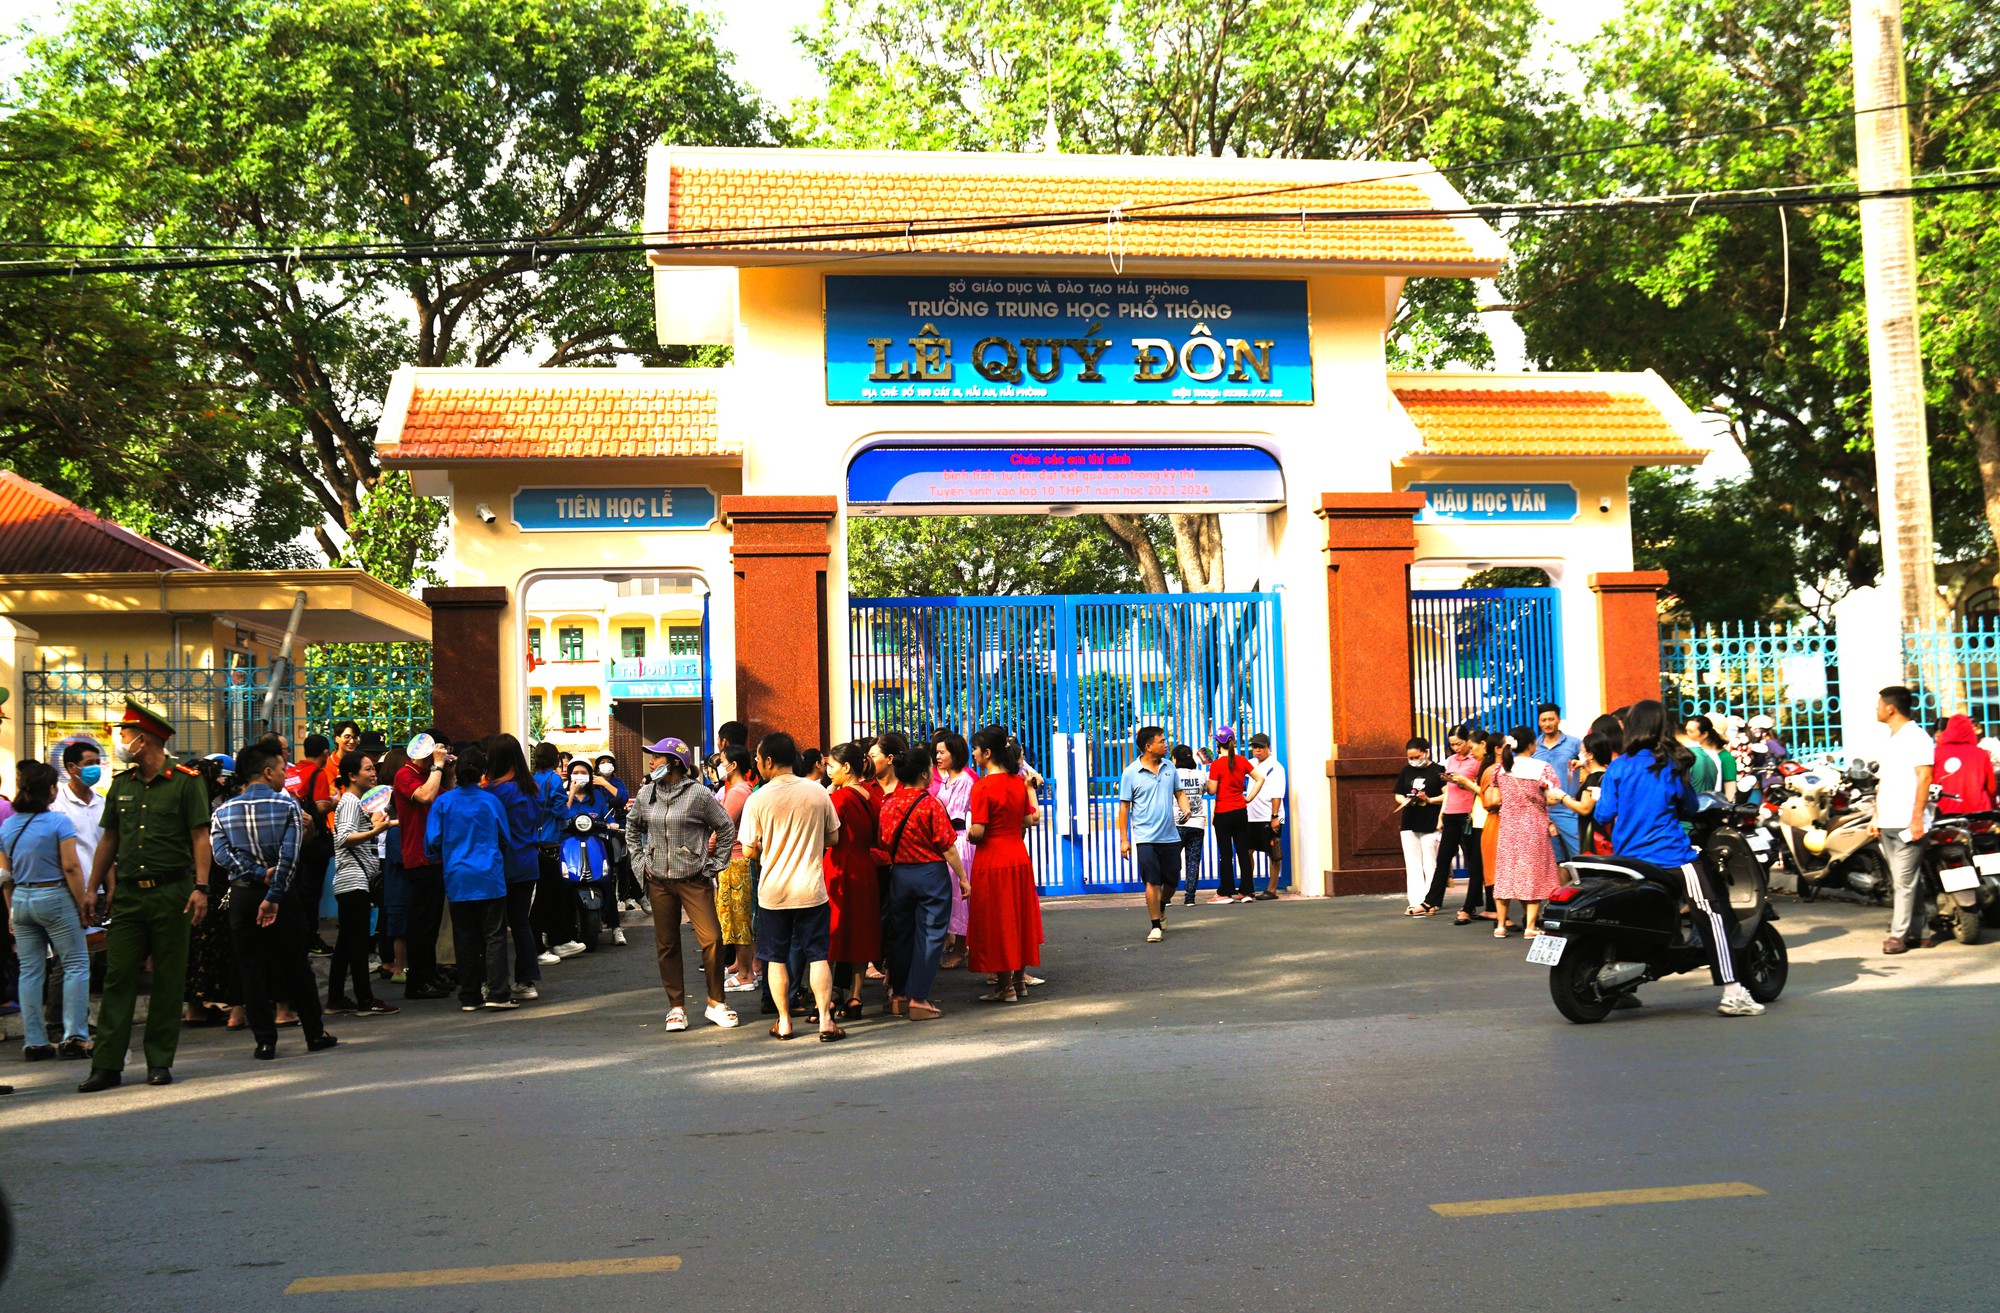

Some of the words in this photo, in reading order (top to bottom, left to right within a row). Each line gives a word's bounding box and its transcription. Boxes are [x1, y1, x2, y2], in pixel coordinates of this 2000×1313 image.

[949, 279, 966, 293] SỞ
[972, 280, 1004, 293] GIÁO
[1007, 282, 1033, 296] DỤC
[1036, 280, 1052, 294] VÀ
[1057, 280, 1084, 294] ĐÀO
[1089, 283, 1112, 297] TẠO
[1117, 281, 1139, 295] HẢI
[1145, 281, 1190, 296] PHÒNG
[908, 296, 989, 318] TRƯỜNG
[996, 300, 1059, 318] TRUNG
[1067, 301, 1110, 323] HỌC
[1118, 295, 1158, 319] PHỔ
[1164, 299, 1232, 320] THÔNG
[867, 323, 953, 382] LÊ
[971, 322, 1113, 384] QUÝ
[1131, 322, 1275, 382] ĐÔN
[1010, 453, 1041, 465] Chúc
[1043, 453, 1065, 465] các
[1067, 455, 1086, 465] em
[1106, 452, 1132, 465] sinh
[943, 469, 969, 481] bình
[1001, 470, 1014, 483] tự
[1038, 469, 1059, 482] đạt
[1060, 468, 1079, 481] kết
[1082, 468, 1104, 482] quả
[1106, 472, 1128, 480] cao
[1130, 470, 1161, 482] trong
[968, 486, 993, 497] sinh
[1042, 485, 1056, 497] 10
[1059, 485, 1092, 496] THPT
[1433, 488, 1468, 517] HẬU
[1472, 492, 1507, 517] HỌC
[1510, 488, 1547, 512] VĂN
[555, 493, 601, 519] TIÊN
[606, 497, 646, 523] HỌC
[650, 489, 674, 518] LỄ
